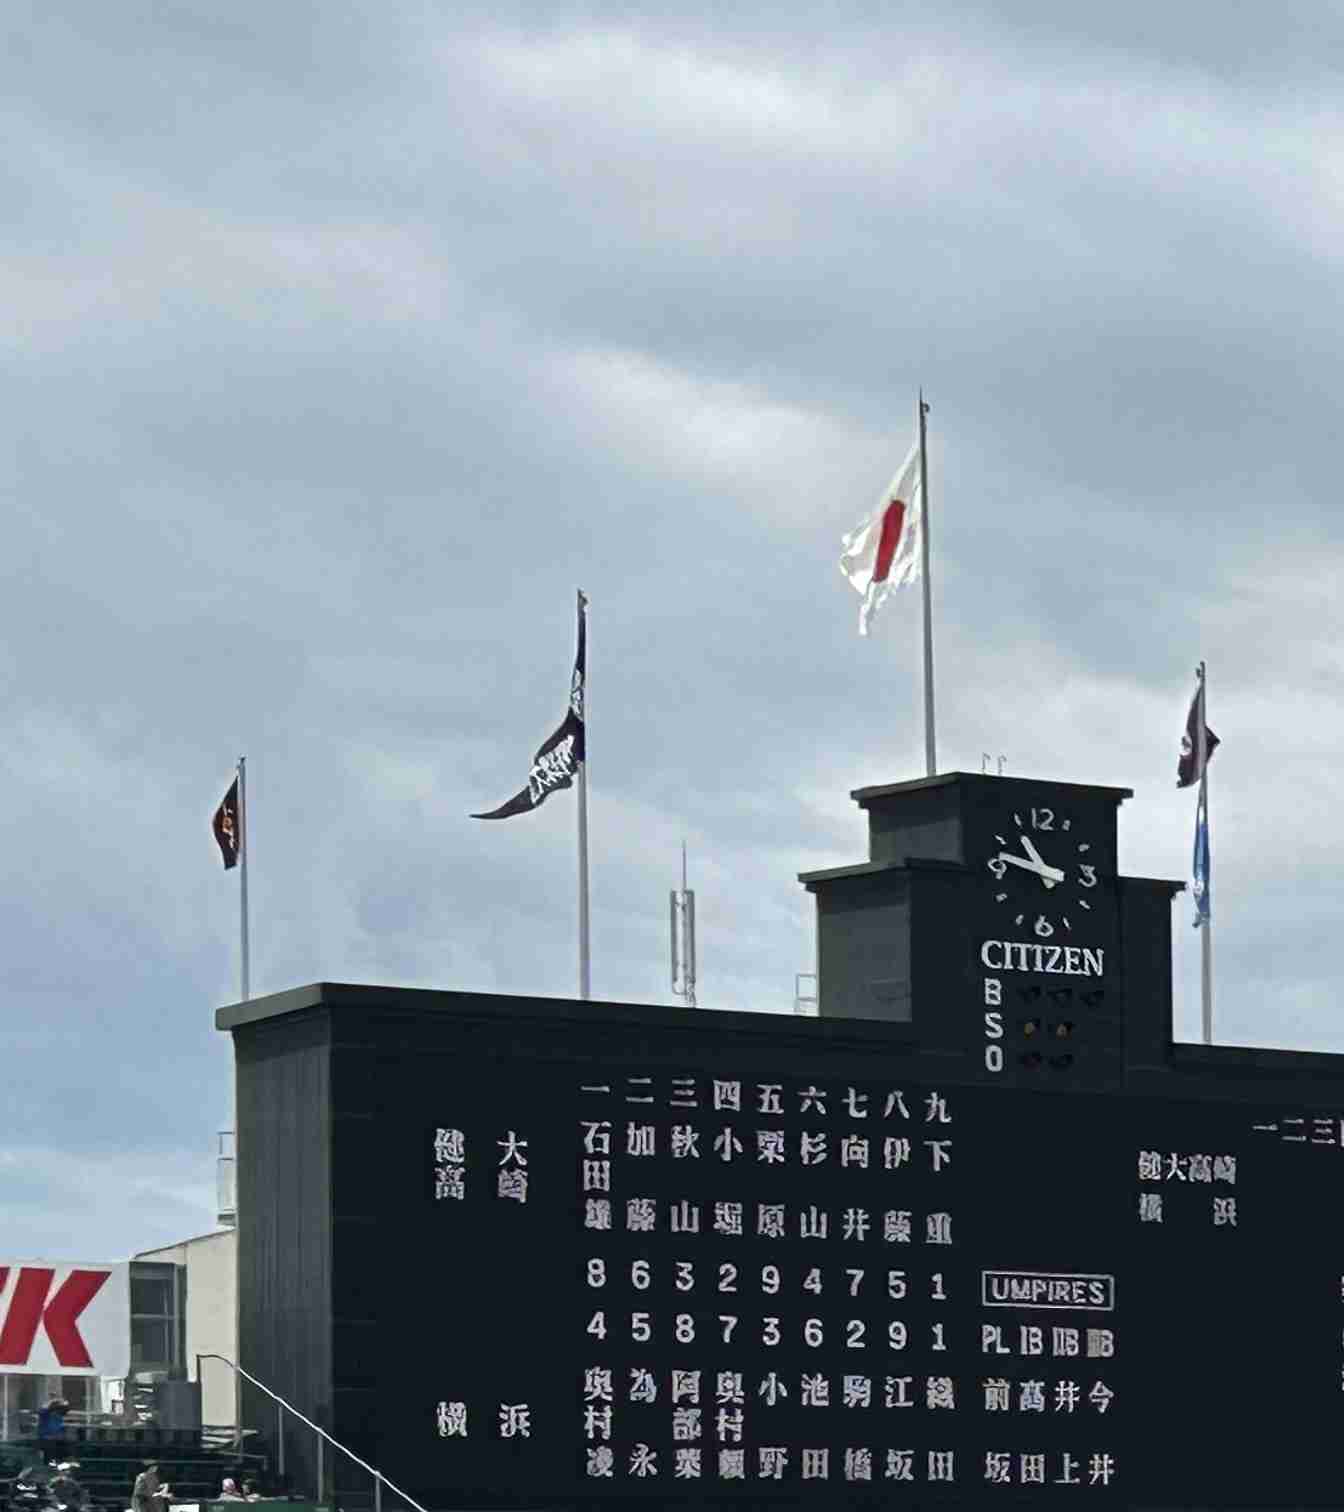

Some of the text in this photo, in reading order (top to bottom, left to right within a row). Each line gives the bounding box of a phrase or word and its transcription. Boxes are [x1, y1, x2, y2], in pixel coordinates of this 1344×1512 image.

[1031, 807, 1055, 831] 12
[1078, 864, 1097, 888] 3
[1034, 915, 1054, 938] 6
[981, 940, 1105, 977] CITIZEN
[984, 977, 1003, 1006] B
[984, 1012, 1004, 1039] S
[984, 1044, 1003, 1073] O
[587, 1258, 947, 1300] 8 6 3 2 9 4 7 5 1
[991, 1279, 1104, 1305] UMPIRES
[0, 1266, 112, 1368] K
[586, 1311, 947, 1351] 4 5 8 7 3 6 2 9 1
[981, 1324, 1011, 1354] PL
